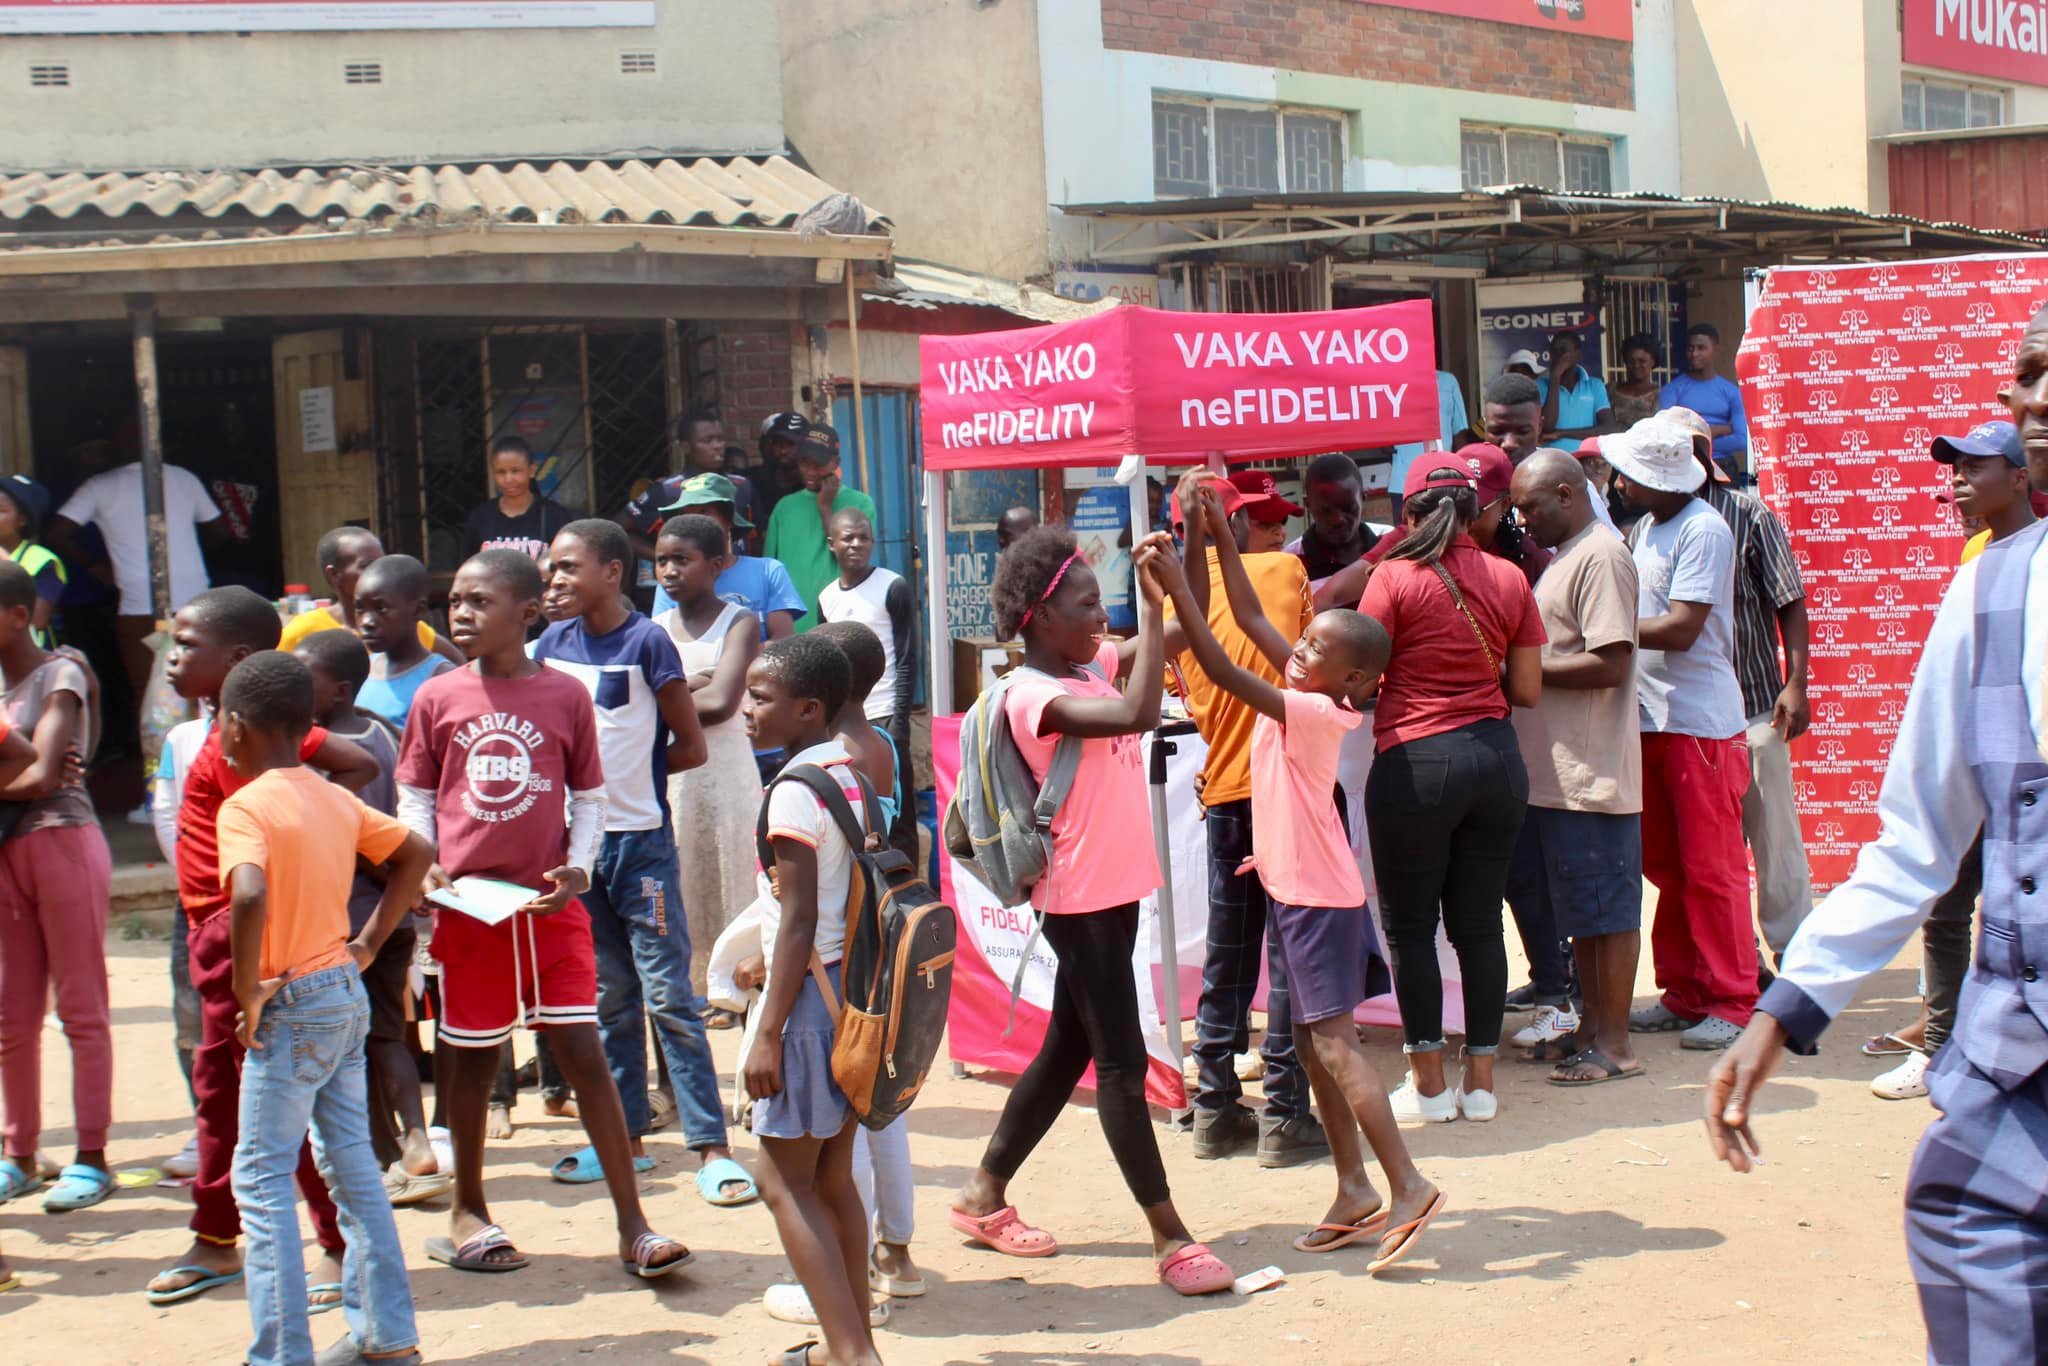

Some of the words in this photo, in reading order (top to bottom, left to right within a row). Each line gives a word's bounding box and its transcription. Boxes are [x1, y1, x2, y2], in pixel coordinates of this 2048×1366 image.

[1107, 285, 1152, 305] CASH
[1864, 293, 1904, 301] SERVICES
[1926, 290, 1967, 298] SERVICES
[1481, 312, 1584, 330] ECONET
[1174, 331, 1293, 369] VAKA
[1299, 327, 1409, 368] YAKO
[1834, 337, 1875, 345] SERVICES
[938, 356, 1013, 396] VAKA
[1015, 342, 1096, 387] YAKO
[1181, 383, 1408, 427] neFIDELITY
[942, 401, 1095, 448] neFIDELITY
[1865, 414, 1906, 422] SERVICES
[946, 553, 988, 584] HONE
[946, 606, 984, 624] EMORY
[454, 713, 544, 750] HARVARD
[470, 756, 526, 781] HBS
[528, 780, 552, 791] 1908
[501, 794, 537, 821] SCHOOL
[980, 906, 1032, 936] FIDELI
